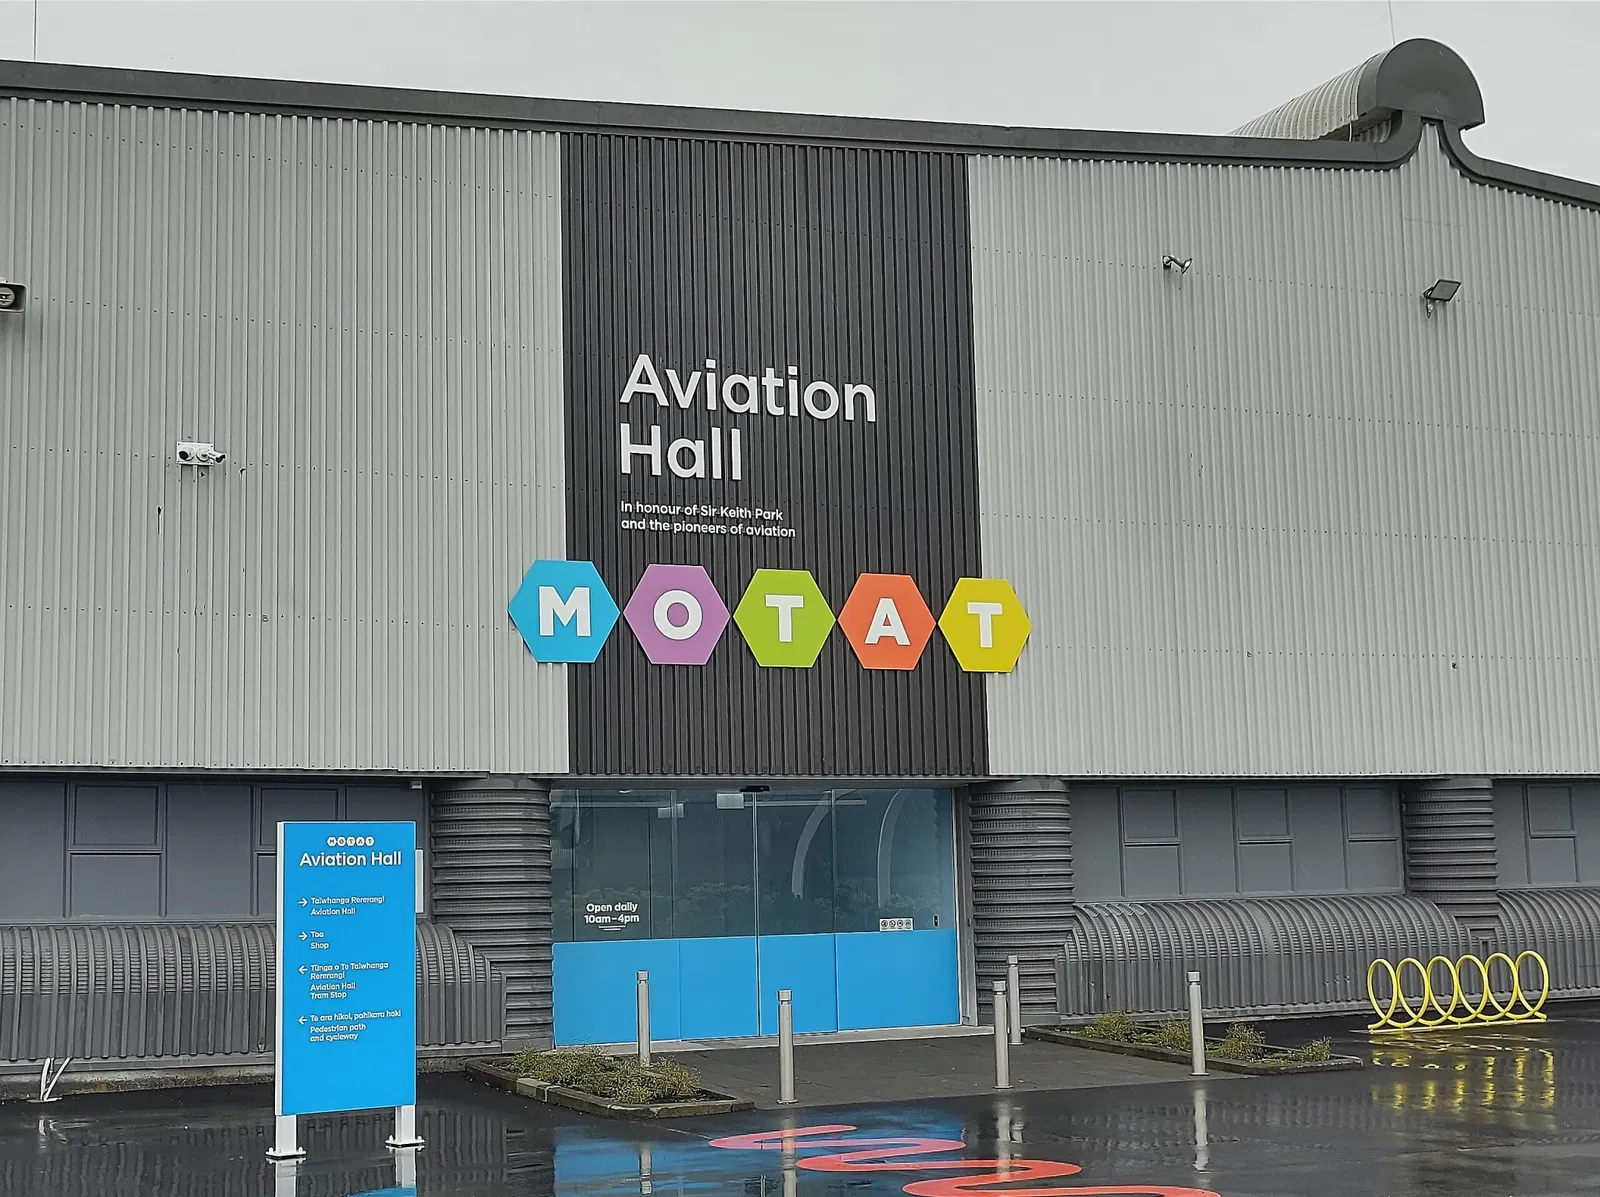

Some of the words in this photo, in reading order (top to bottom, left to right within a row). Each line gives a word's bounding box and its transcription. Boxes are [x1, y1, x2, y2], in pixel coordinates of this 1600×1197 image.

[619, 353, 876, 422] Aviation
[620, 422, 742, 481] Hall
[621, 501, 632, 513] In
[636, 501, 681, 516] honour
[684, 503, 698, 516] of
[701, 504, 716, 518] Sir
[720, 505, 751, 519] Keith
[755, 508, 783, 521] Park
[621, 518, 646, 531] and
[649, 519, 670, 532] the
[673, 521, 727, 538] pioneers
[730, 524, 743, 535] of
[746, 524, 796, 537] aviation
[538, 585, 1003, 649] MOTAT
[299, 852, 367, 867] Aviation
[371, 851, 402, 866] Hall
[311, 896, 350, 905] Taiwhanga
[351, 895, 385, 905] Rererangi
[310, 908, 341, 916] Aviation
[342, 907, 356, 915] Hall
[586, 903, 612, 913] Open
[614, 902, 638, 912] daily
[310, 942, 330, 950] Shop
[310, 983, 340, 992] Aviation
[341, 982, 356, 990] Hall
[311, 992, 329, 1000] Tram
[330, 990, 347, 999] Stop
[310, 1025, 348, 1034] Pedestrian
[349, 1023, 366, 1032] path
[325, 1033, 359, 1042] cycleway
